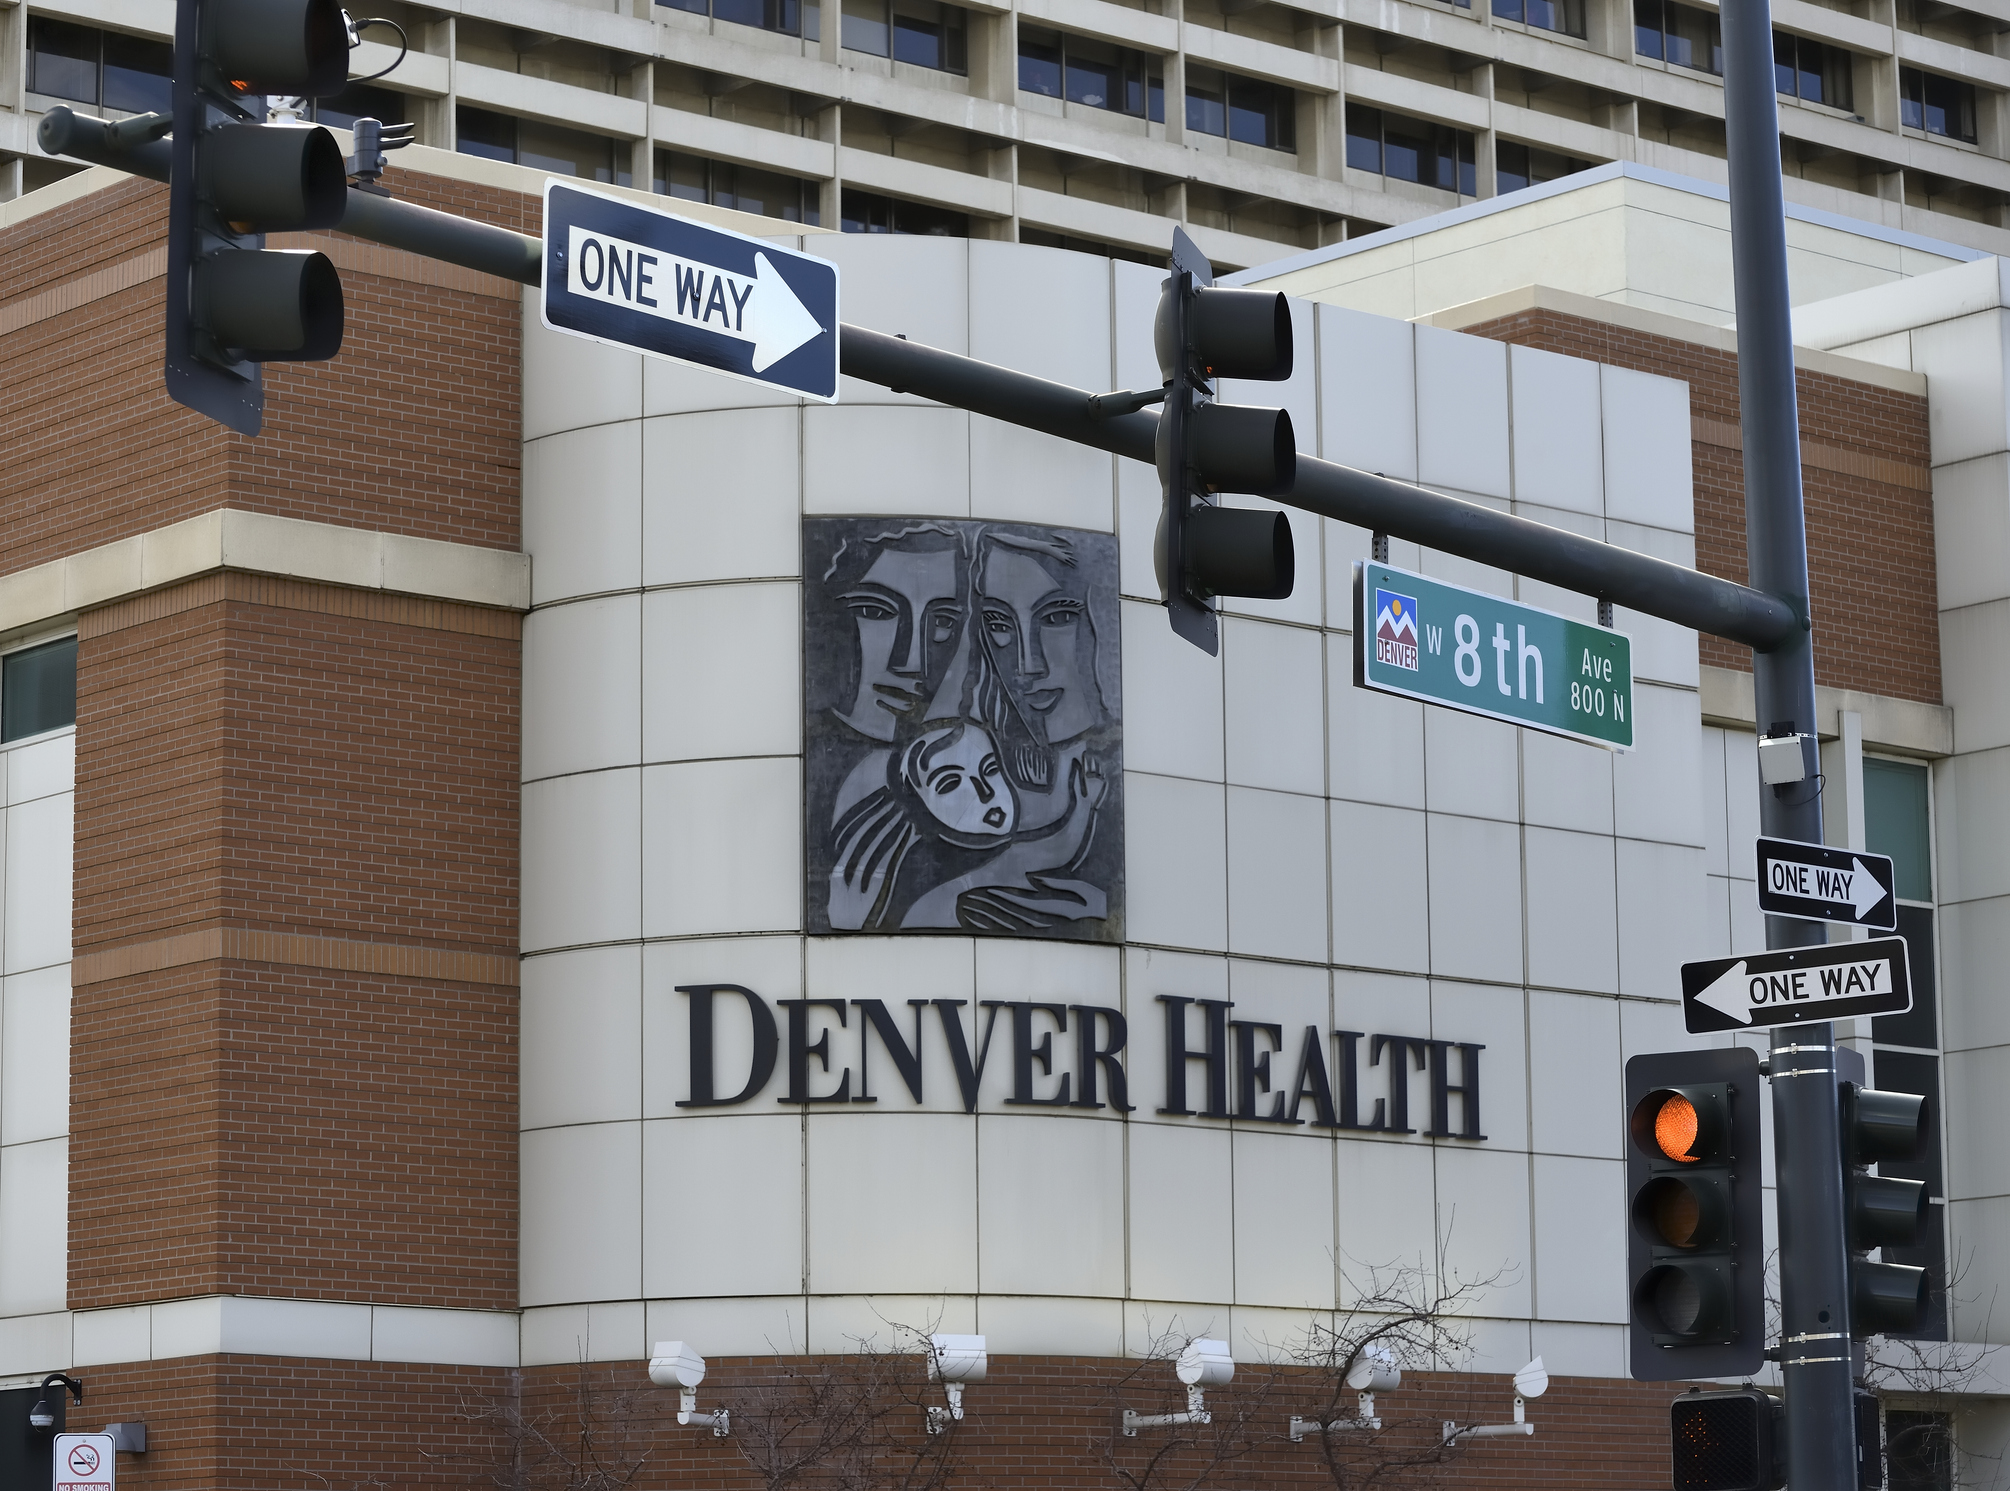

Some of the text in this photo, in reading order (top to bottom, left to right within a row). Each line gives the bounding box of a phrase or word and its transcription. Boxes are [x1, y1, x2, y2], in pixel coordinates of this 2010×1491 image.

[579, 238, 754, 332] ONE WAY
[1377, 638, 1418, 670] DENVER
[1426, 613, 1612, 705] W 8th Ave
[1570, 681, 1624, 723] 800 N
[1772, 863, 1853, 900] ONE WAY
[1749, 963, 1882, 1004] ONE WAY
[674, 983, 1488, 1141] DENVER HEALTH
